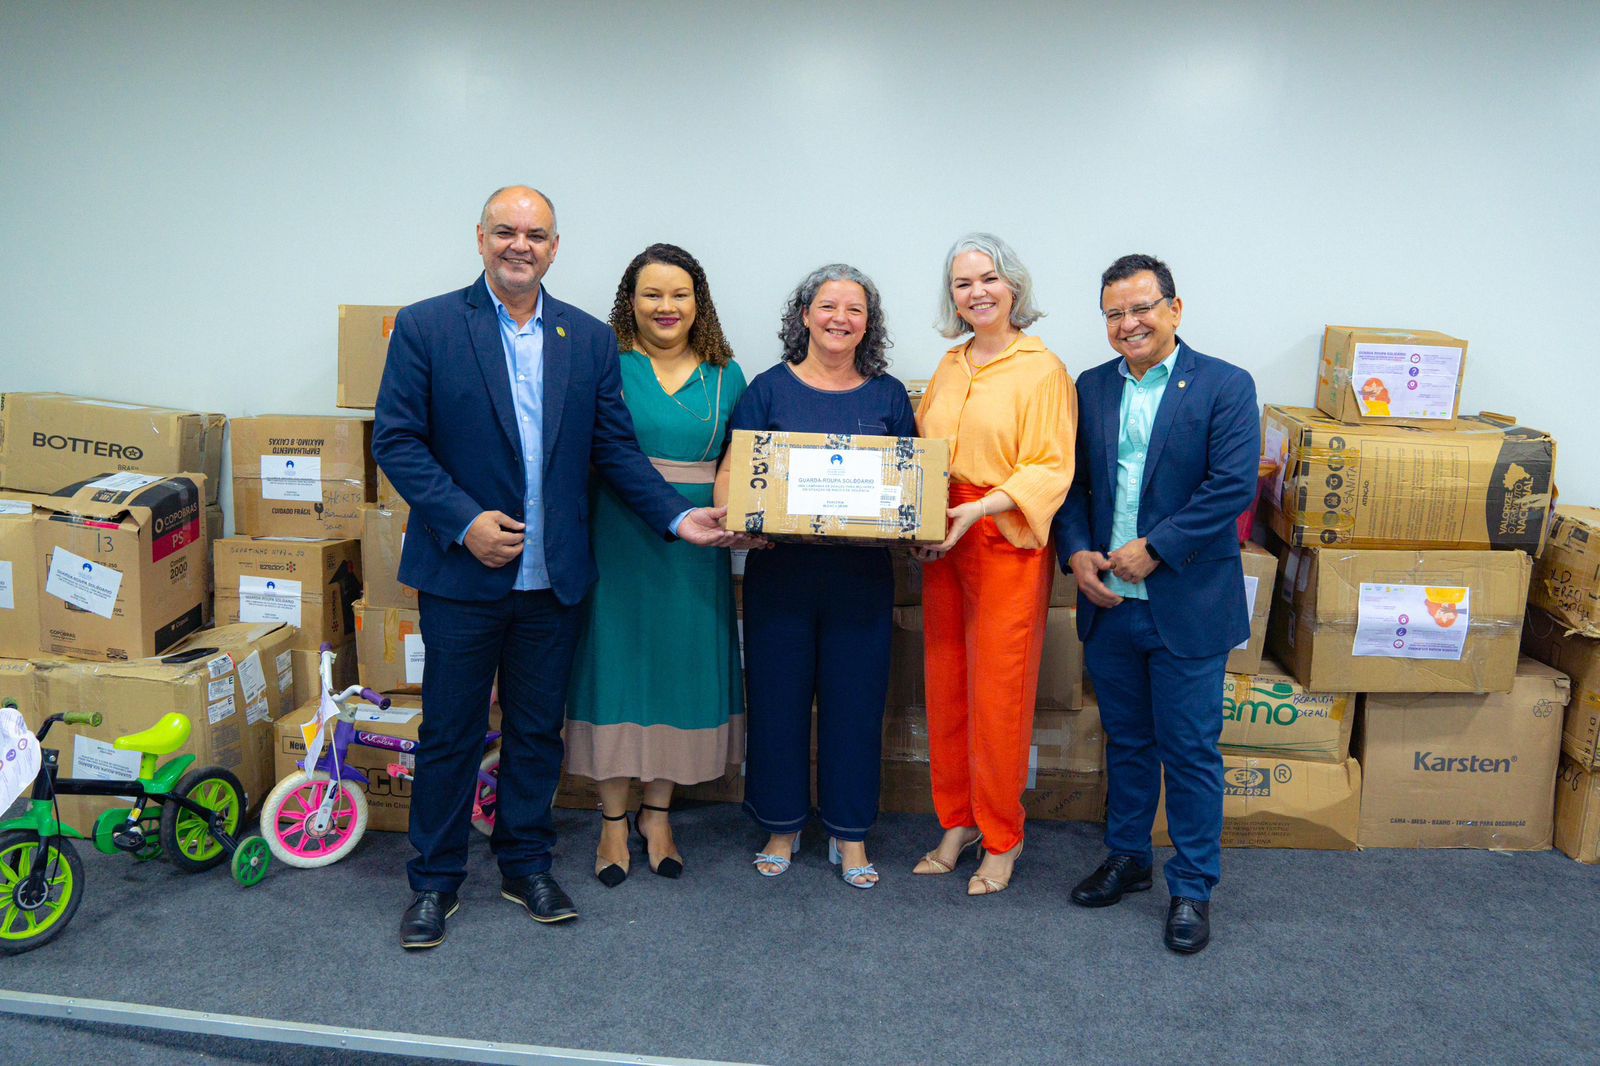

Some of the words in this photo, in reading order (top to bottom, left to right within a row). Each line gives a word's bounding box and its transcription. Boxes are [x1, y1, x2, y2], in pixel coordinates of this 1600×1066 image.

[33, 432, 144, 461] BOTTERO
[272, 447, 321, 455] EMPILHAMENTO
[165, 502, 198, 526] COPOBRAS
[272, 507, 292, 515] CUIDADO
[1499, 491, 1514, 535] VALORIZE
[97, 532, 114, 553] 13
[172, 530, 185, 549] PS
[170, 561, 188, 580] 2000
[289, 740, 306, 751] New
[1413, 751, 1511, 773] Karsten
